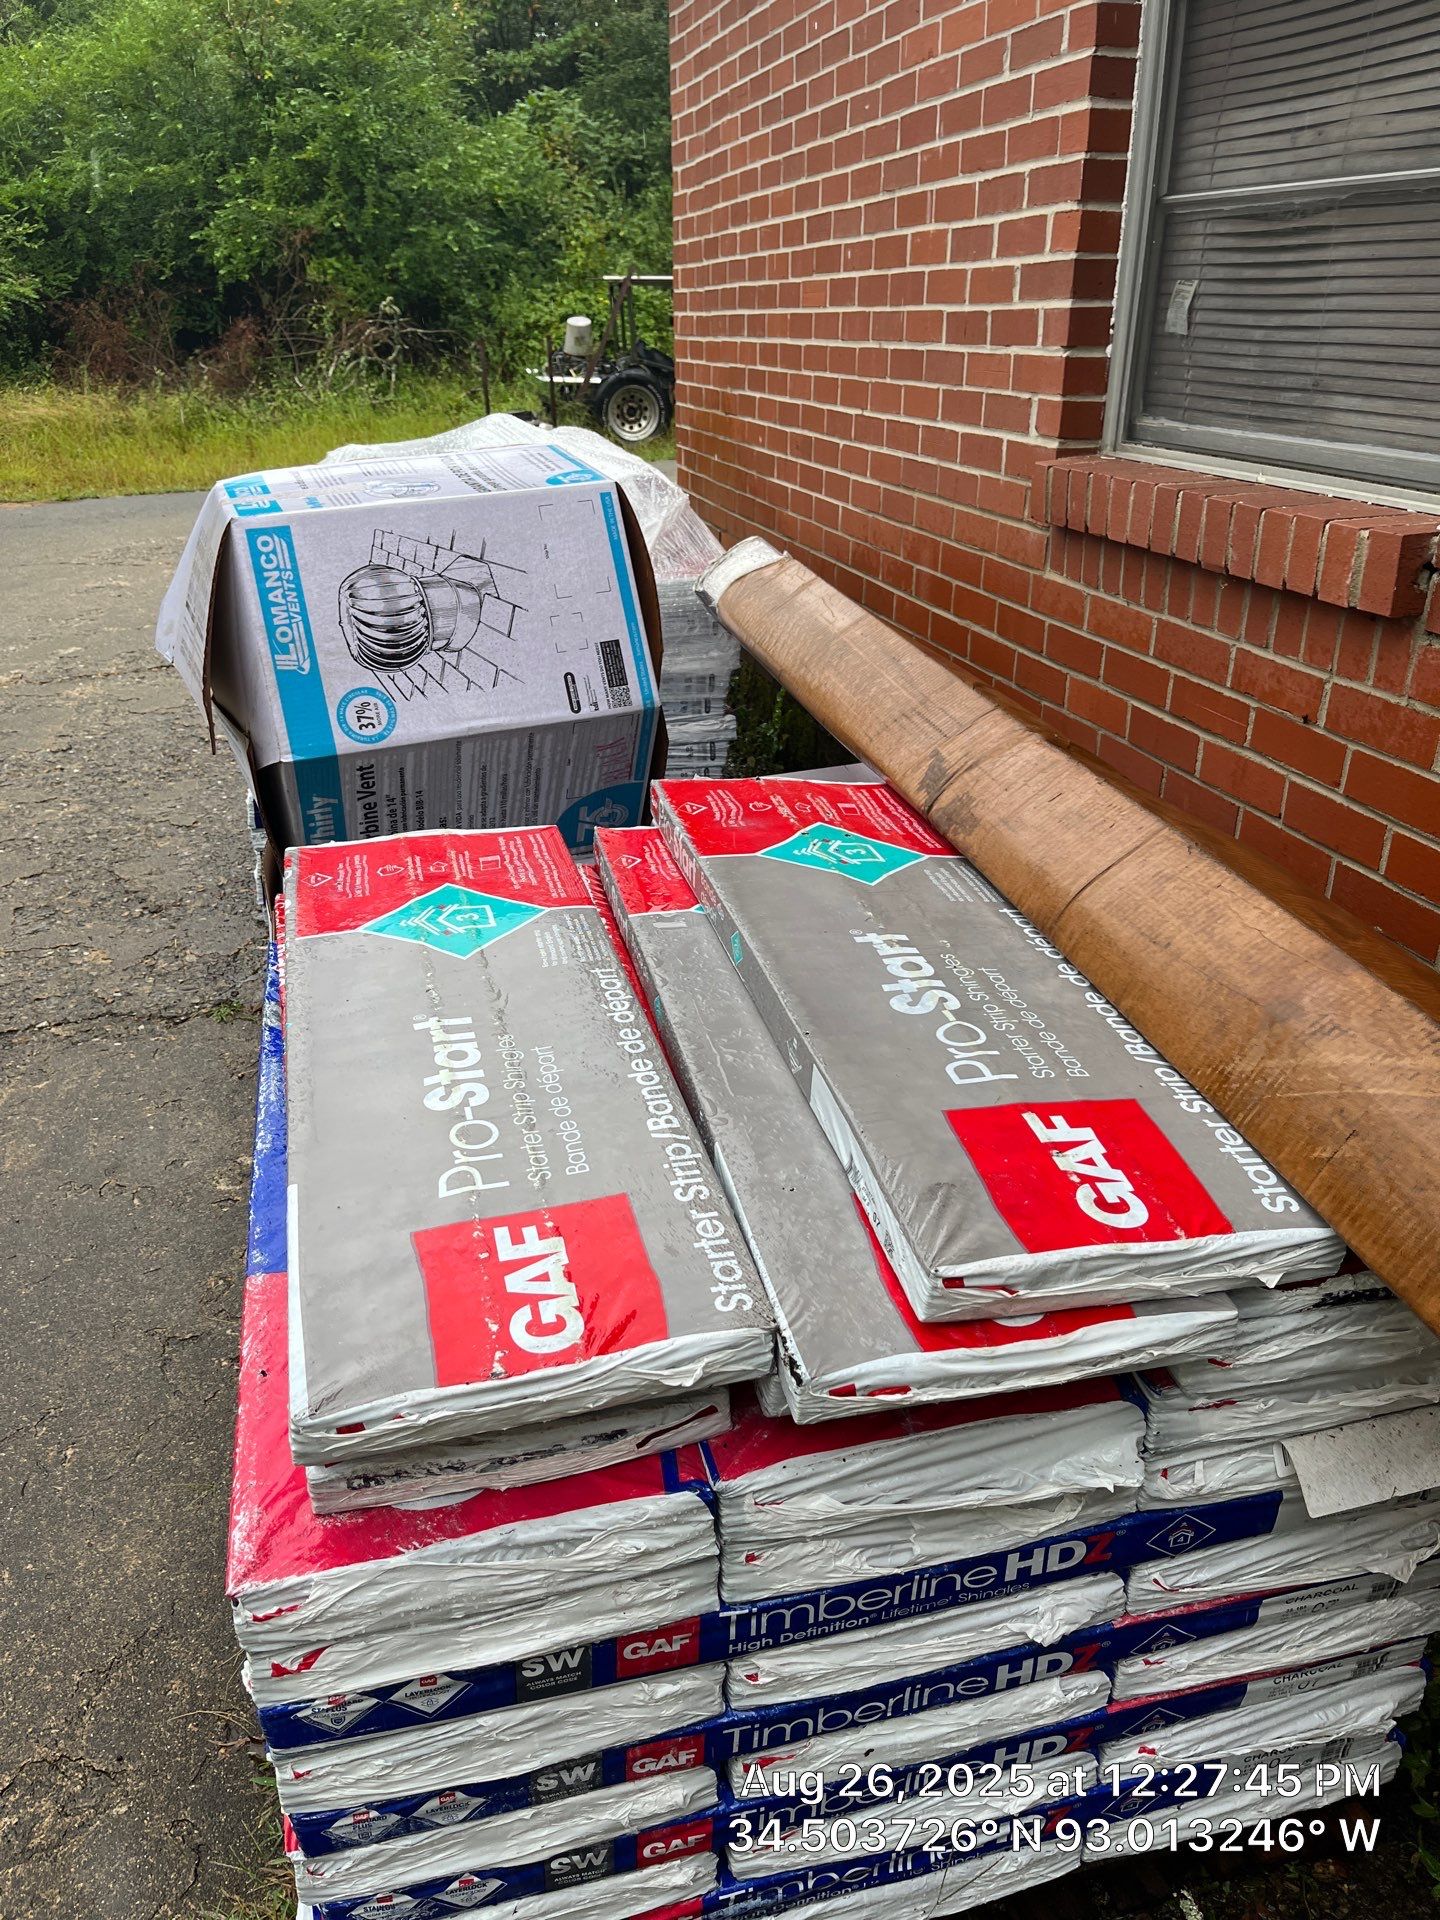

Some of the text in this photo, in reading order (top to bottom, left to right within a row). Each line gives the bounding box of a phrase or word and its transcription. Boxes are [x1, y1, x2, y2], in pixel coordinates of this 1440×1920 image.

[610, 526, 618, 540] MADE
[257, 535, 299, 670] LOMANCO
[284, 570, 303, 622] VENTS
[600, 672, 608, 686] VENTS
[354, 702, 376, 730] 37%
[373, 702, 383, 726] MORE AIR
[398, 766, 408, 796] permanente
[356, 764, 380, 838] rbine Vent
[387, 808, 398, 818] de
[415, 790, 424, 810] BIB-14
[438, 816, 448, 828] as:
[940, 953, 989, 1002] Shingles
[1057, 963, 1090, 987] de
[590, 968, 635, 1023] départ
[978, 967, 1090, 1077] Bande de départ
[983, 1004, 1018, 1031] Strip
[616, 1028, 646, 1053] de
[1005, 1034, 1056, 1079] Starter
[496, 1034, 551, 1181] Starter Strip Shingles
[530, 1045, 590, 1175] Bande de départ
[1021, 1111, 1149, 1228] GAF
[1203, 1118, 1300, 1214] Starter
[687, 1210, 753, 1312] Starter
[493, 1226, 585, 1354] GAF
[718, 1531, 1117, 1640] Timberline HDZ
[1285, 1583, 1359, 1605] CHARCOAL
[728, 1636, 773, 1655] High
[780, 1616, 869, 1643] Definition
[958, 1581, 1030, 1602] Shingles
[623, 1633, 692, 1660] GAF
[521, 1647, 585, 1678] SW
[404, 1685, 452, 1698] LAYERLOCK
[526, 1671, 582, 1687] ALWAYS MATCH
[530, 1677, 579, 1690] COLOR CODE
[325, 1705, 348, 1713] PLUS
[722, 1642, 1102, 1754] Timberline HDZ
[994, 1727, 1094, 1767] HDZ
[632, 1749, 697, 1774] GAF
[536, 1762, 596, 1792] SW
[425, 1801, 472, 1815] LAYERLOCK
[643, 1833, 706, 1859] GAF
[550, 1850, 608, 1875] SW
[445, 1882, 489, 1896] LAYERLOCK
[554, 1873, 580, 1882] ALWAYS
